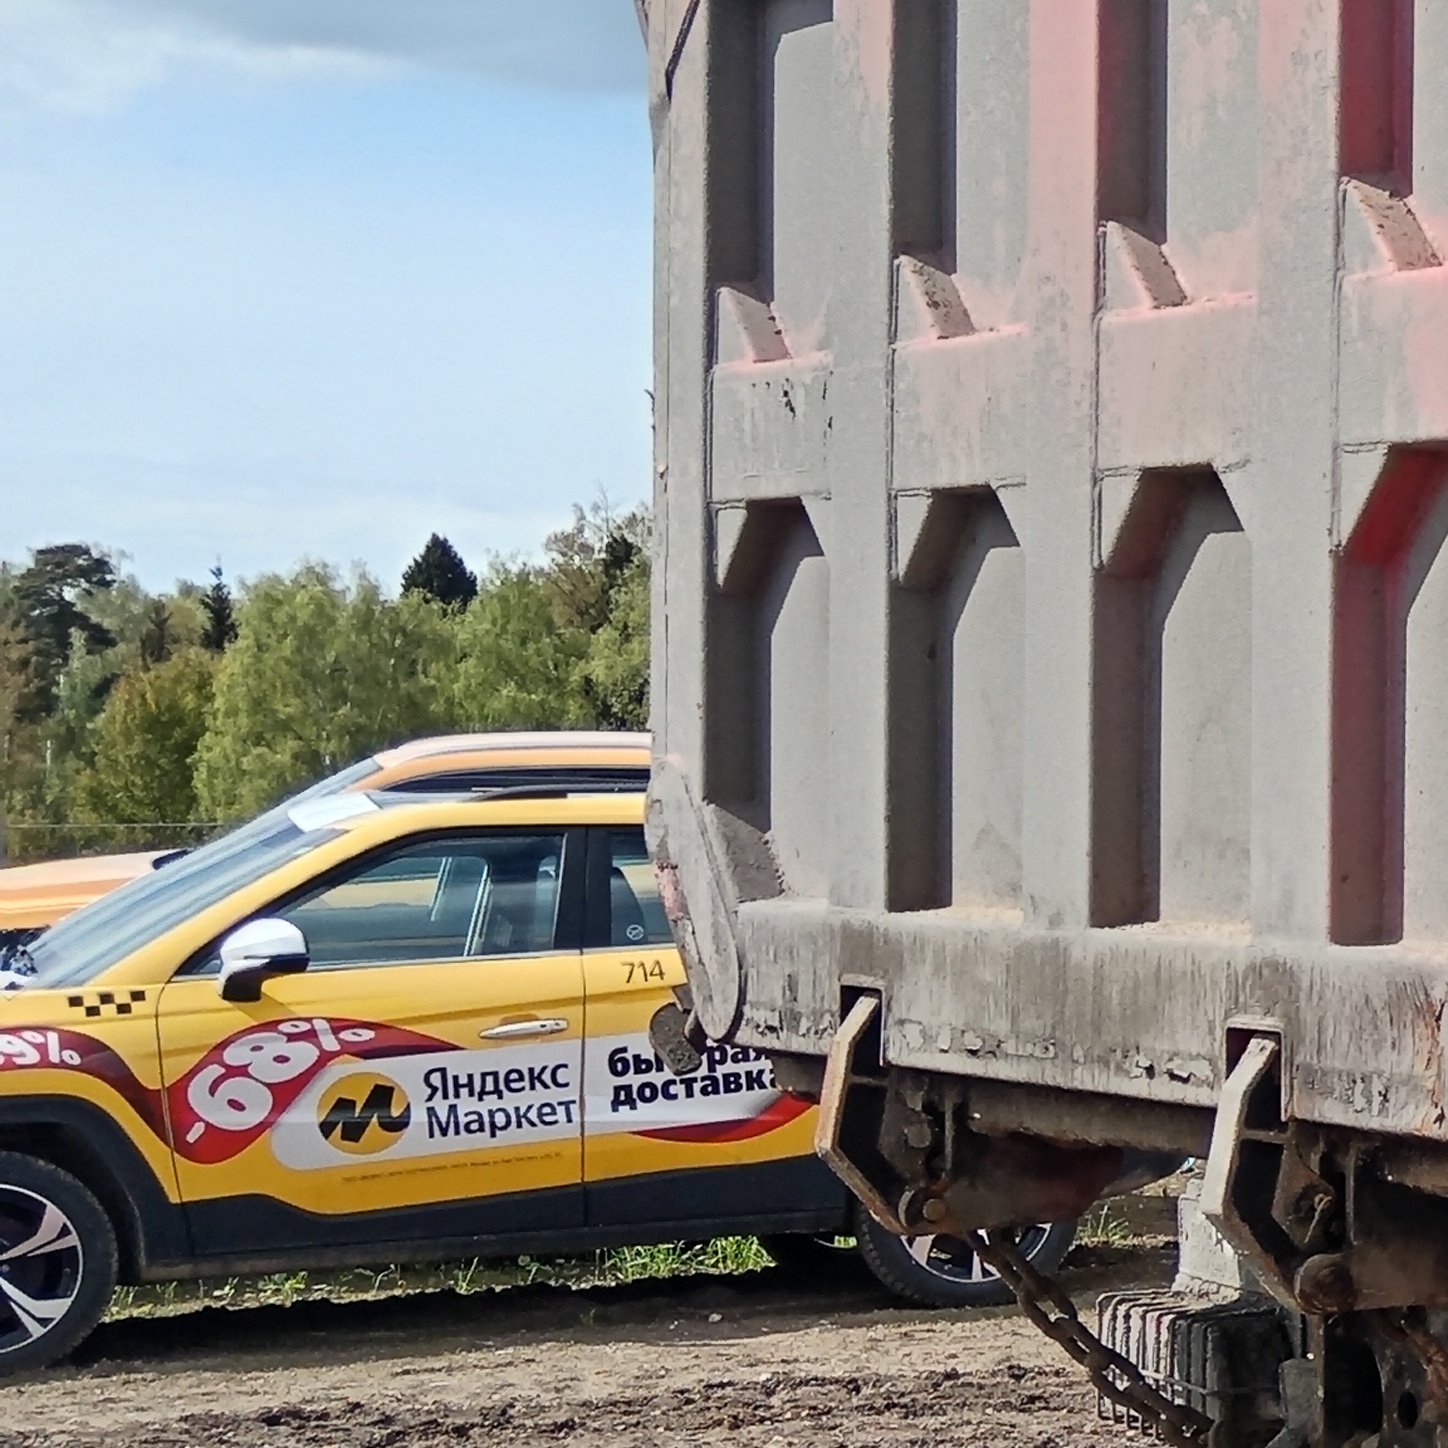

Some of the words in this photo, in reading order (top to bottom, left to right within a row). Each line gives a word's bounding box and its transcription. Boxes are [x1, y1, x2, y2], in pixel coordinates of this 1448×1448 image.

[620, 960, 666, 984] 714
[186, 1018, 376, 1144] -68%
[423, 1062, 571, 1103] Яндекс
[425, 1098, 578, 1140] Маркет
